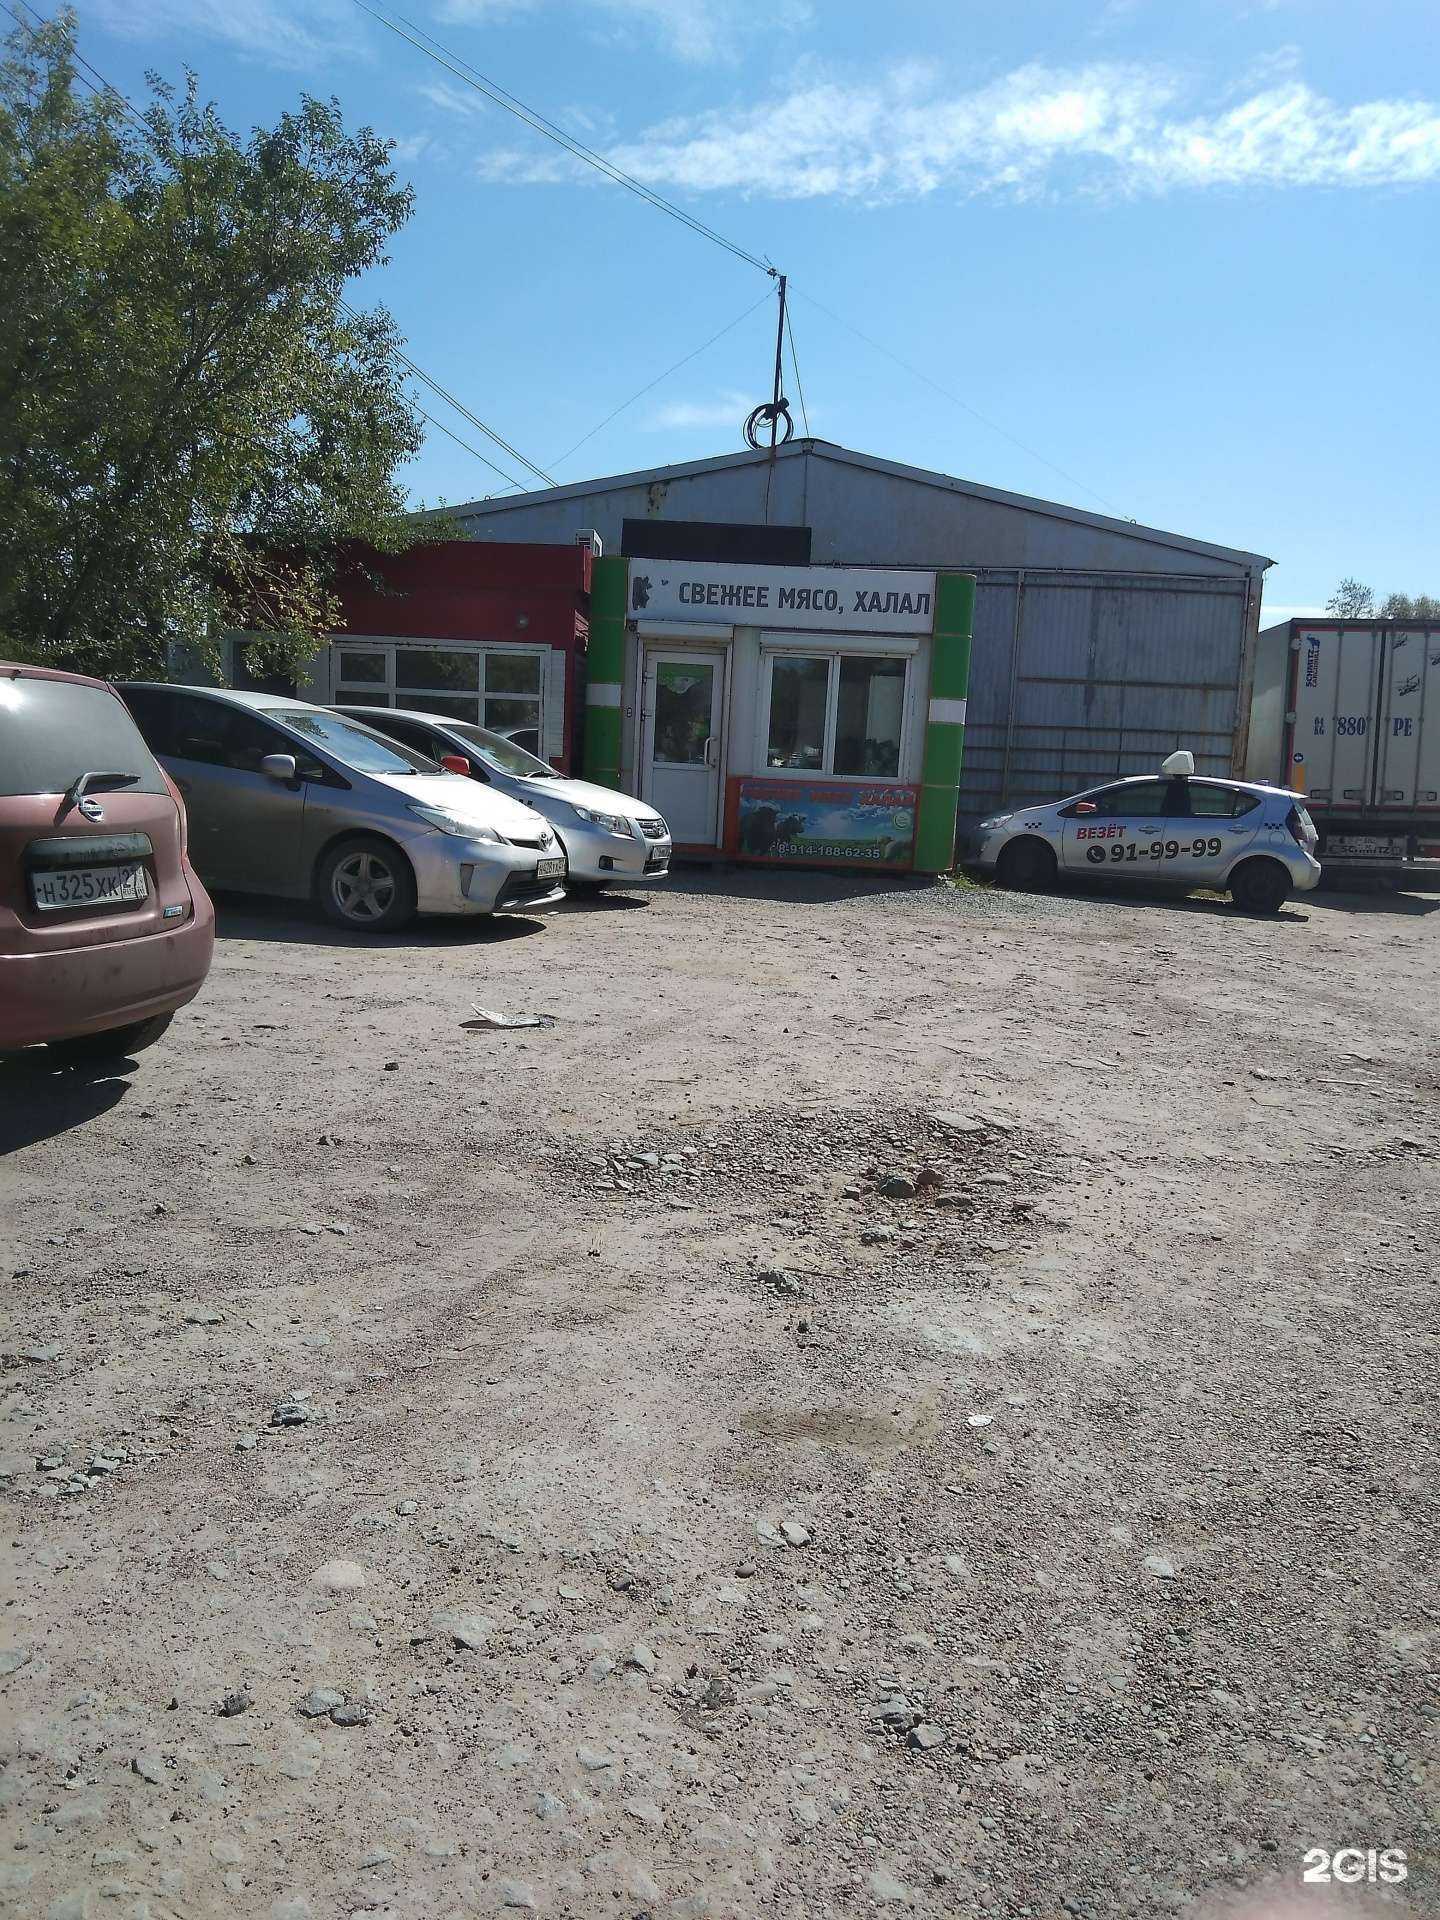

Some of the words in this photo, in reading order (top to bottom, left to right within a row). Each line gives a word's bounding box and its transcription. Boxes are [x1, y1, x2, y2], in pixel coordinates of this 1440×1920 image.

[678, 582, 770, 608] СВЕЖЕЕ
[777, 588, 844, 614] МЯСО,
[853, 590, 931, 615] ХАЛАЛ
[1337, 716, 1366, 736] 880
[1392, 717, 1413, 737] PE
[1076, 823, 1127, 840] ВЕЗЁТ
[1110, 837, 1222, 863] 91-99-99
